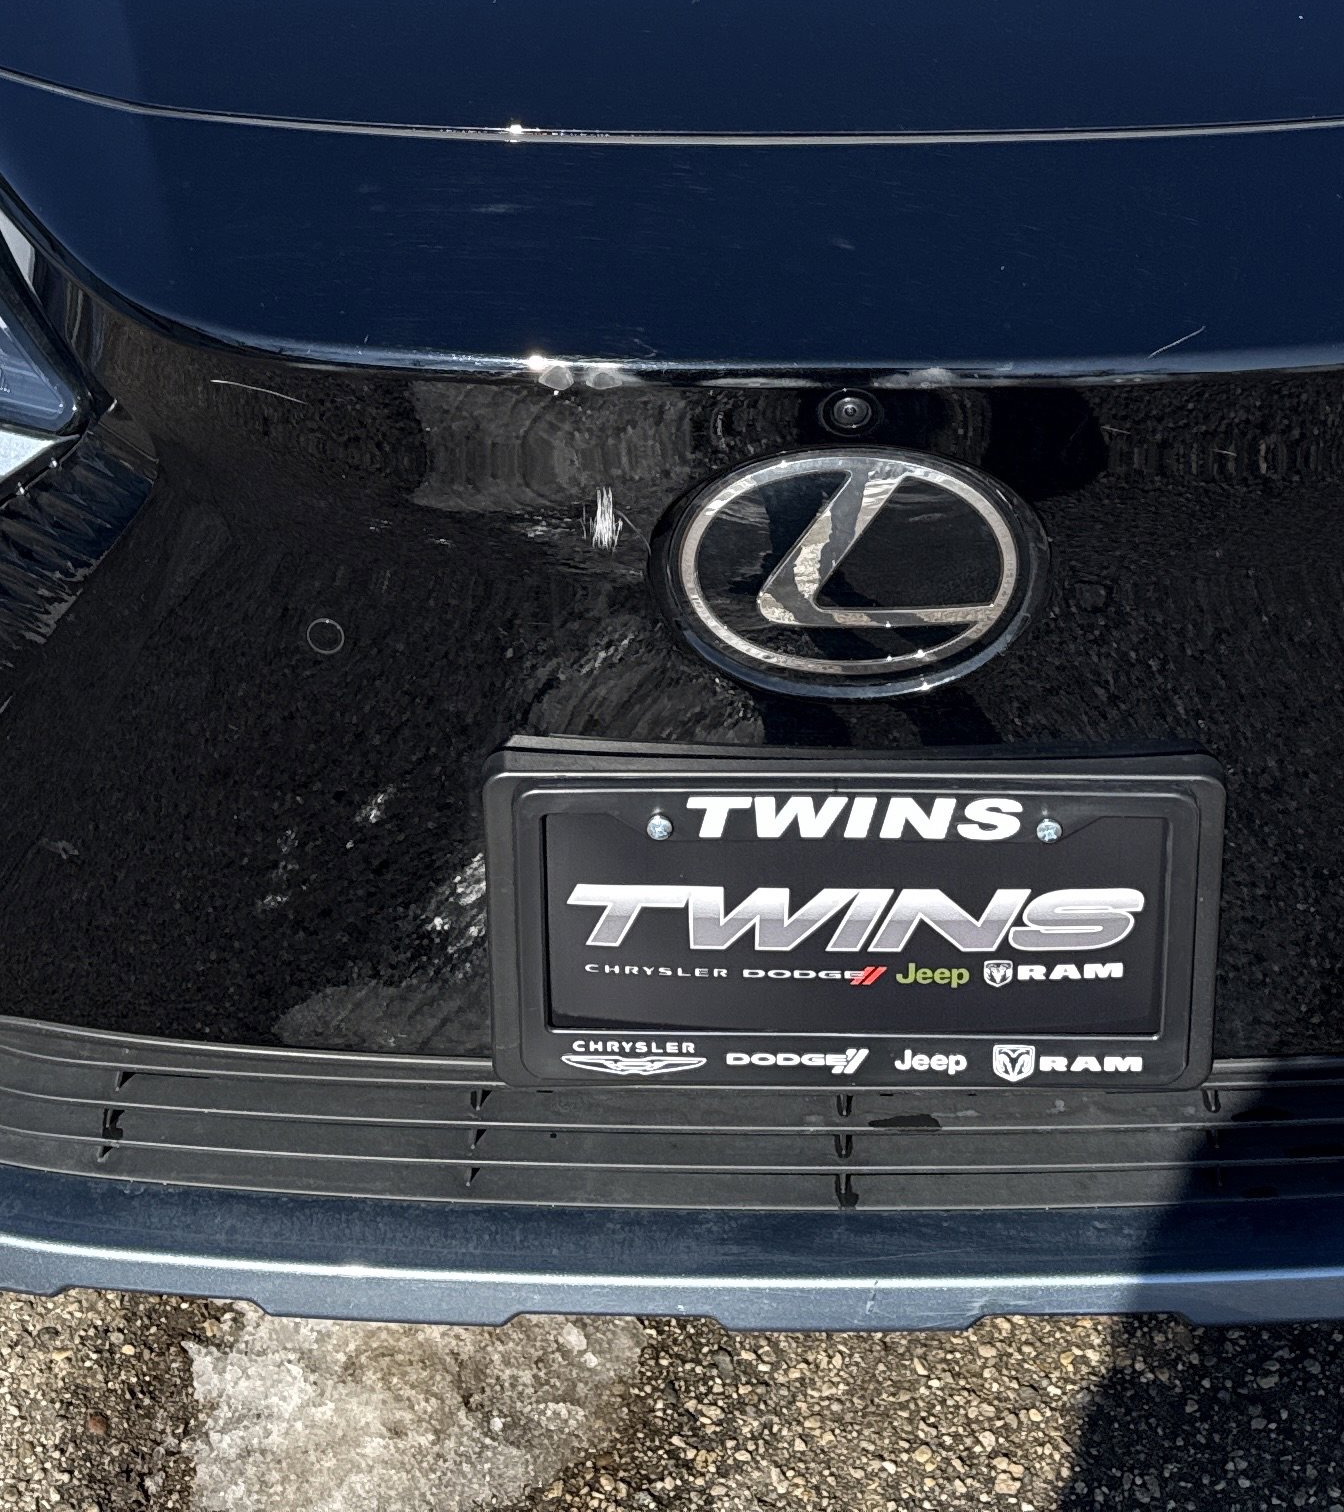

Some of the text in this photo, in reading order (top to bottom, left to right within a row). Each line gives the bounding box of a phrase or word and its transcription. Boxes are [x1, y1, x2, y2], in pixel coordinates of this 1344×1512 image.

[687, 796, 1023, 840] TWINS
[567, 884, 1145, 952] TWINS
[584, 962, 1124, 988] CHRYSLER DODGE Jeep RAM
[571, 1039, 1143, 1075] CHRYSLER DODGE Jeep RAM
